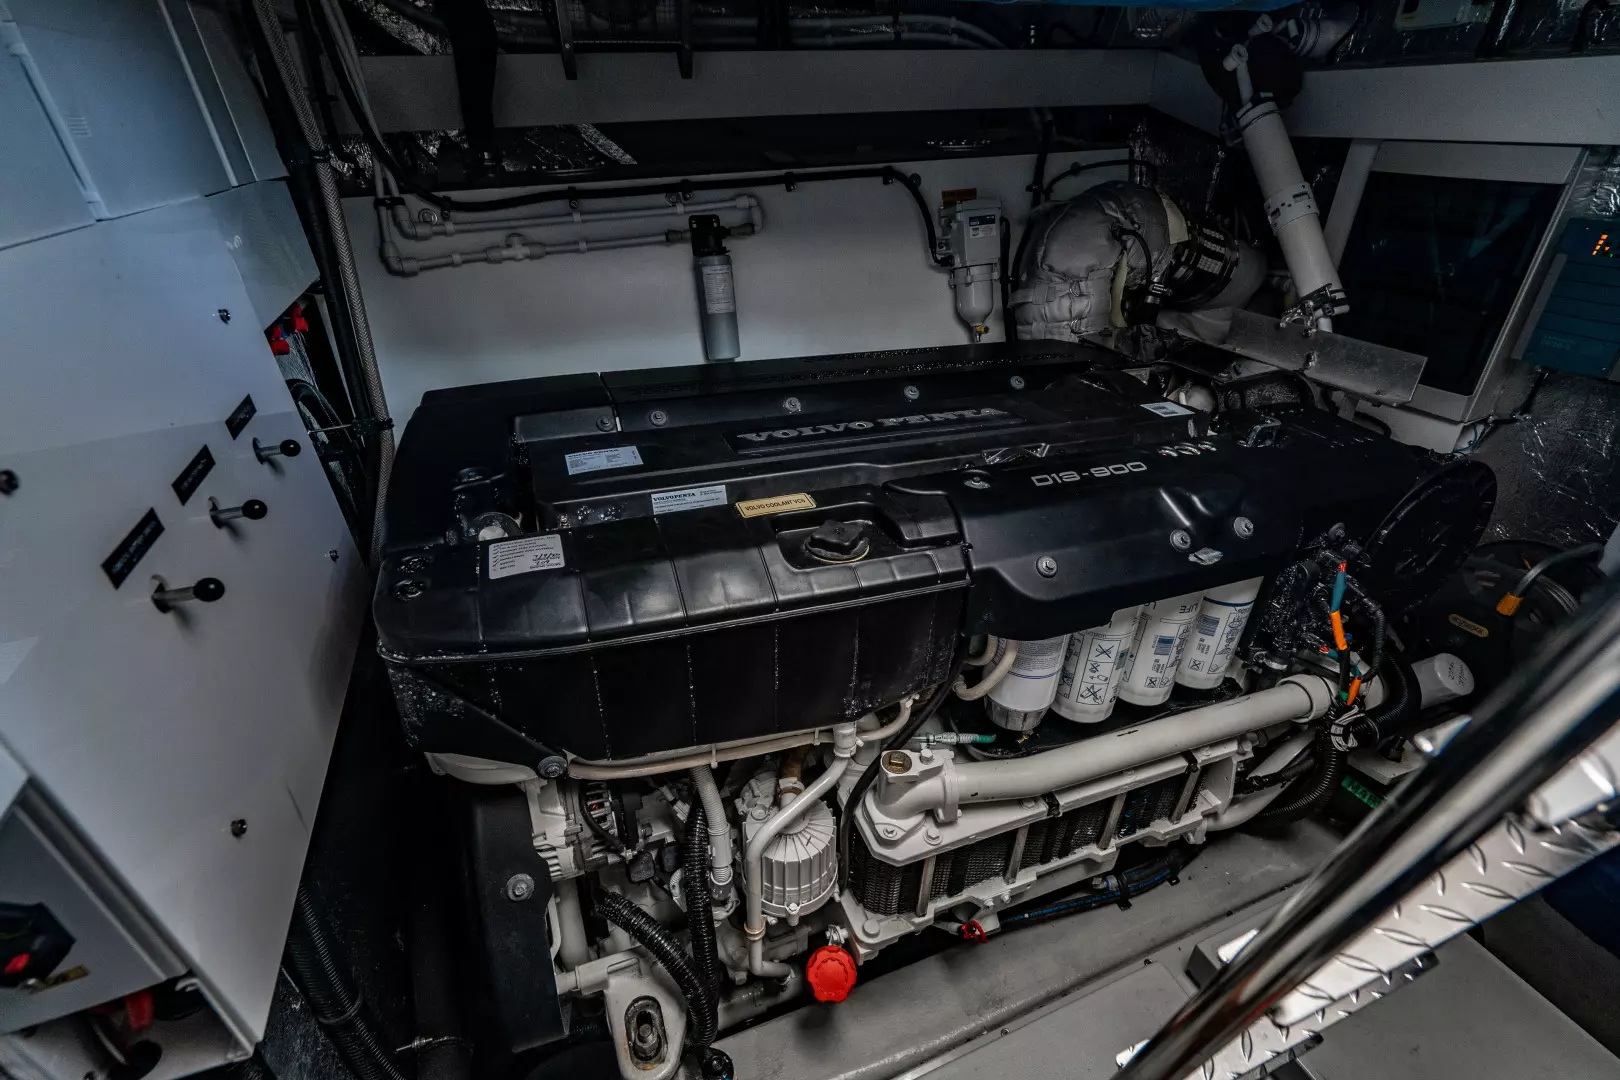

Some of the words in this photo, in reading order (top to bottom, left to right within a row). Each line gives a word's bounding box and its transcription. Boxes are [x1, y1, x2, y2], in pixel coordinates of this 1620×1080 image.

[736, 420, 875, 442] VOLVO
[876, 407, 1009, 427] PENTA
[1029, 461, 1148, 487] D13-900
[744, 502, 765, 511] VOLVO
[765, 498, 793, 508] COOLANT
